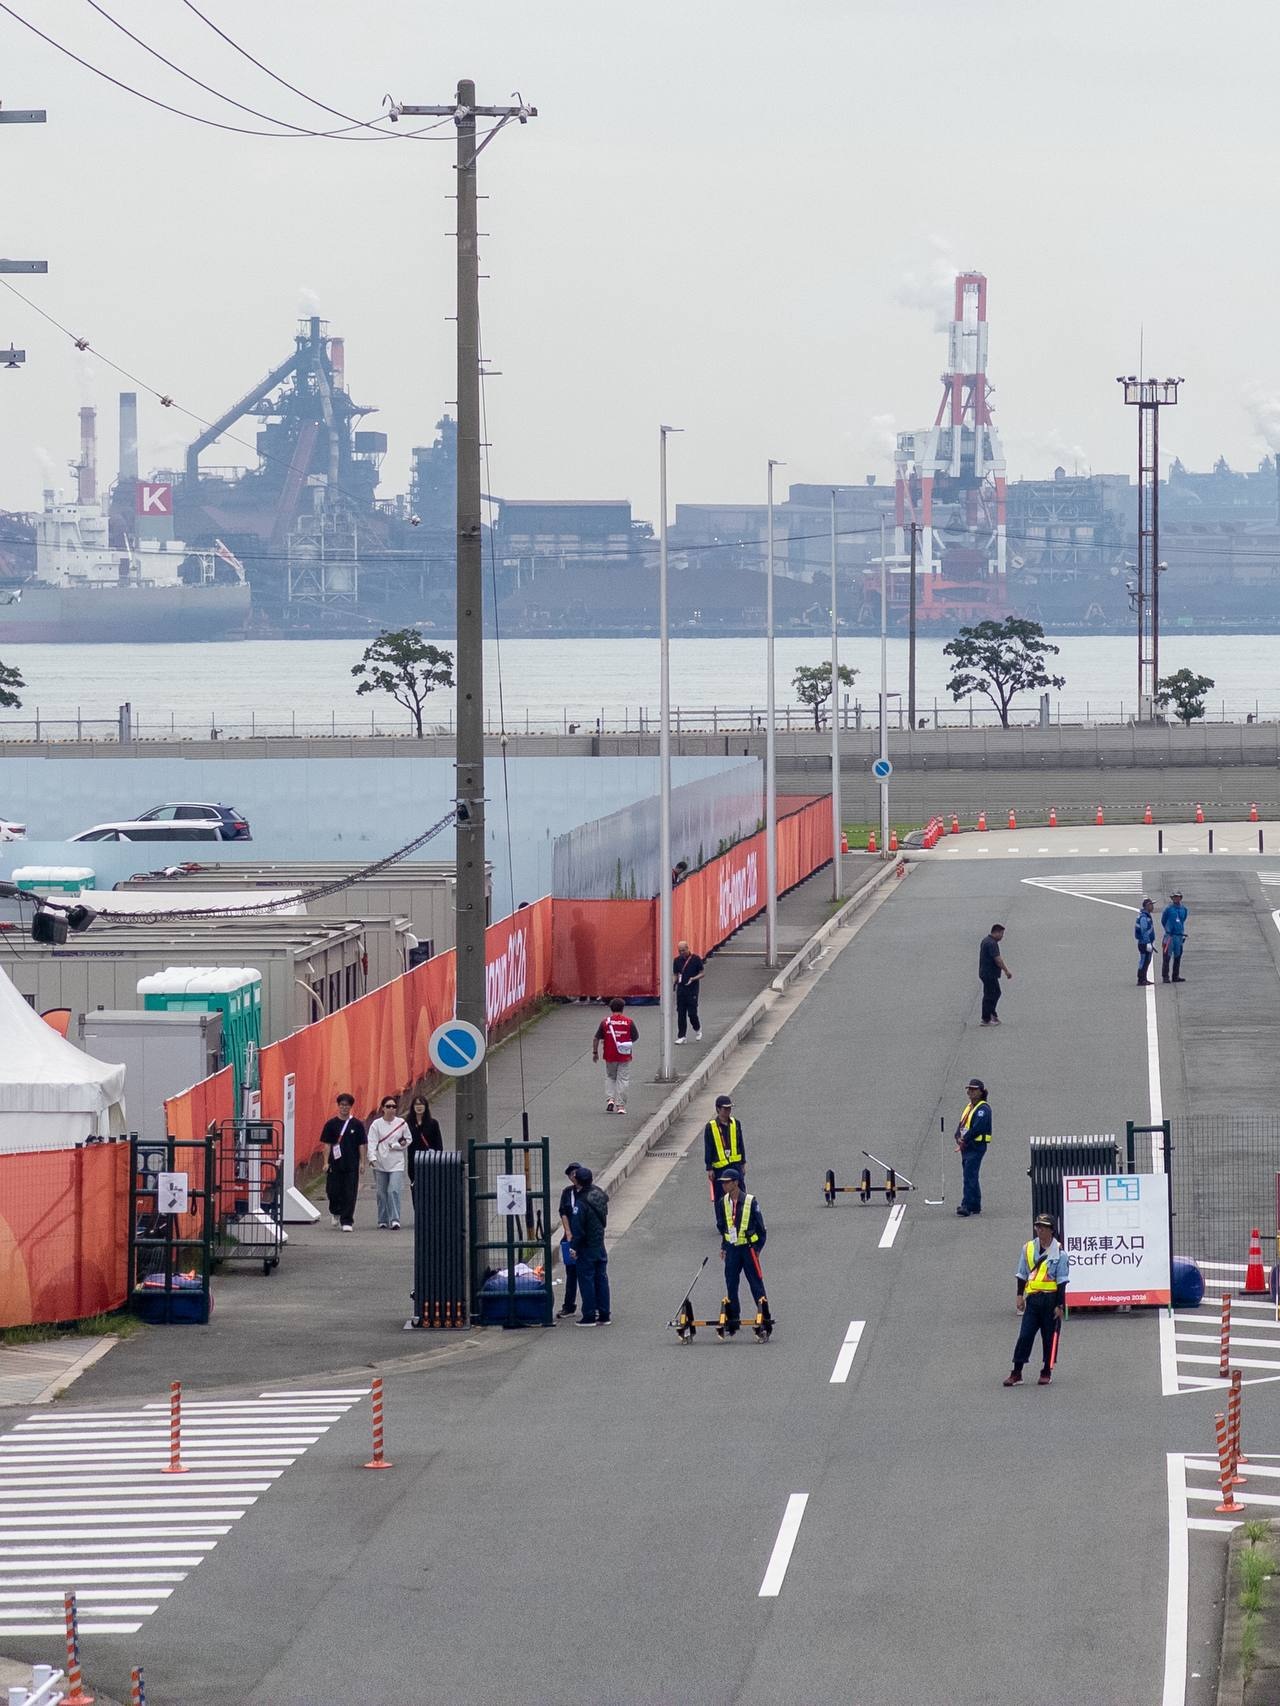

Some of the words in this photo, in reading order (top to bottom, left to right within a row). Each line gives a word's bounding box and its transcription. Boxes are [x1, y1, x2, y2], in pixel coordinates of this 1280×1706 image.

[143, 487, 167, 511] K
[1067, 1235, 1145, 1252] 関係車入口
[1068, 1253, 1107, 1266] Staff
[1111, 1252, 1144, 1268] Only
